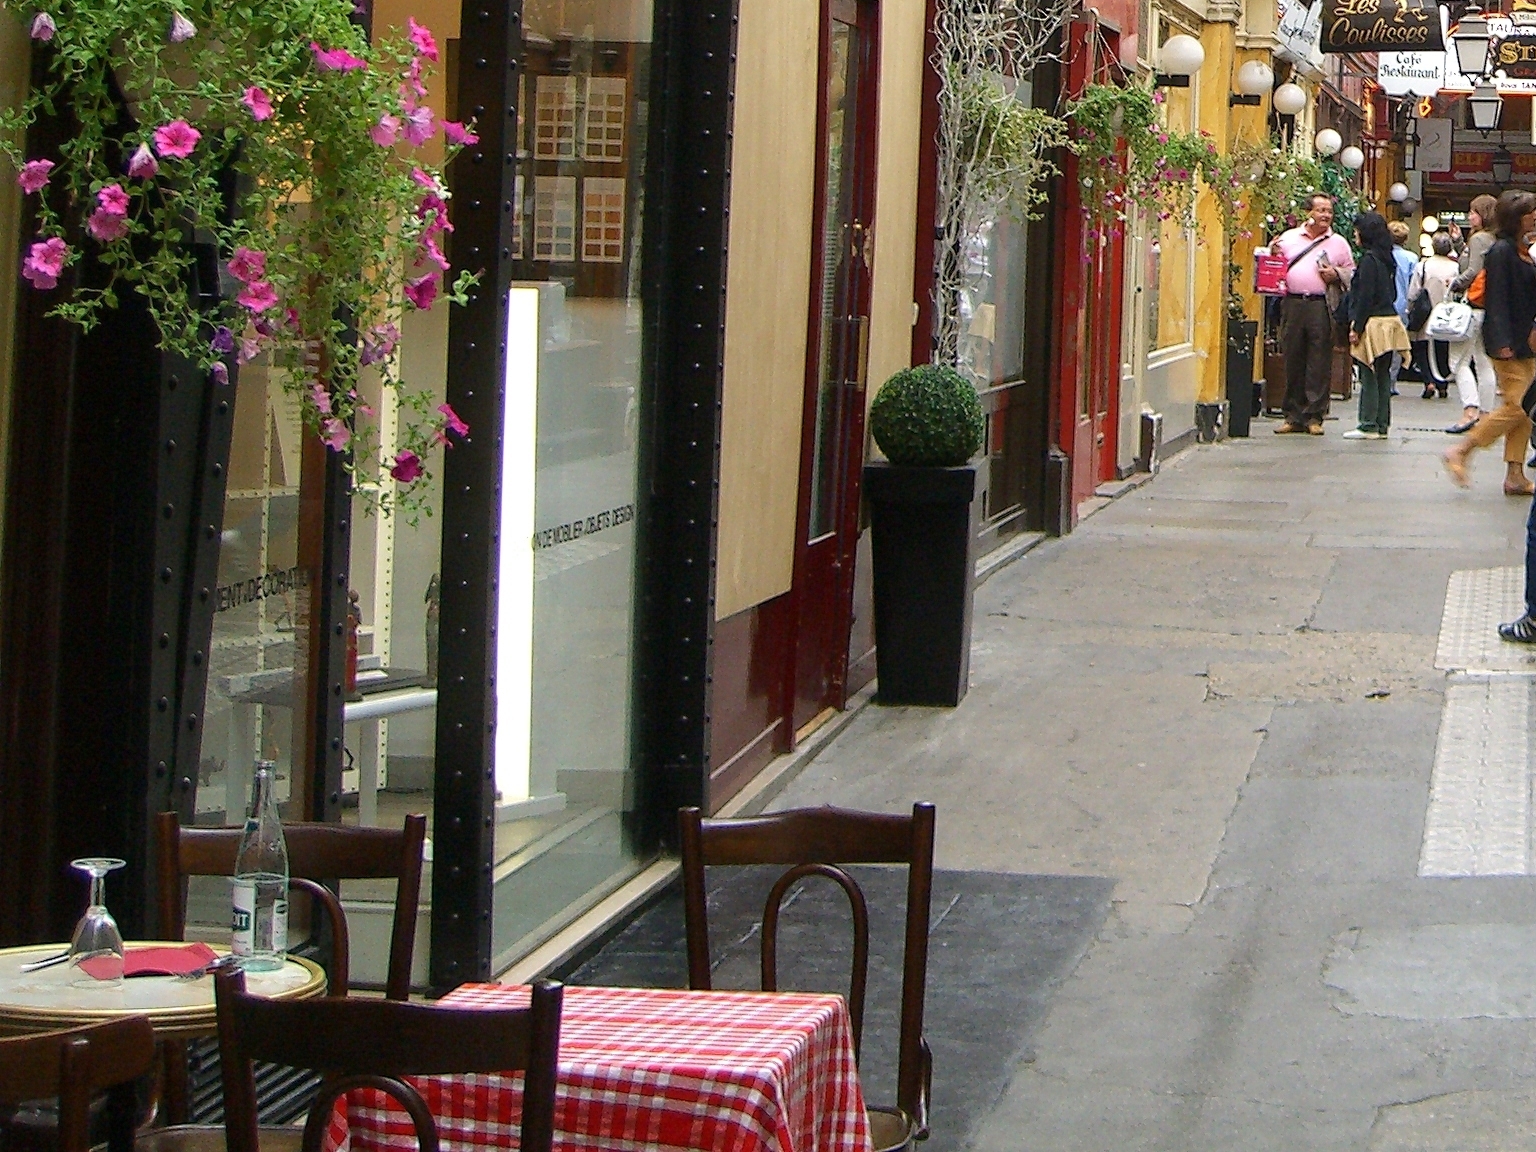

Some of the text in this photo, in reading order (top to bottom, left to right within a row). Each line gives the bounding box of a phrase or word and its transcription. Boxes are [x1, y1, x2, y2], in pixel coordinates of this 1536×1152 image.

[1328, 17, 1428, 47] Coulisses
[1396, 51, 1422, 65] Café
[1380, 64, 1440, 80] Restaurant
